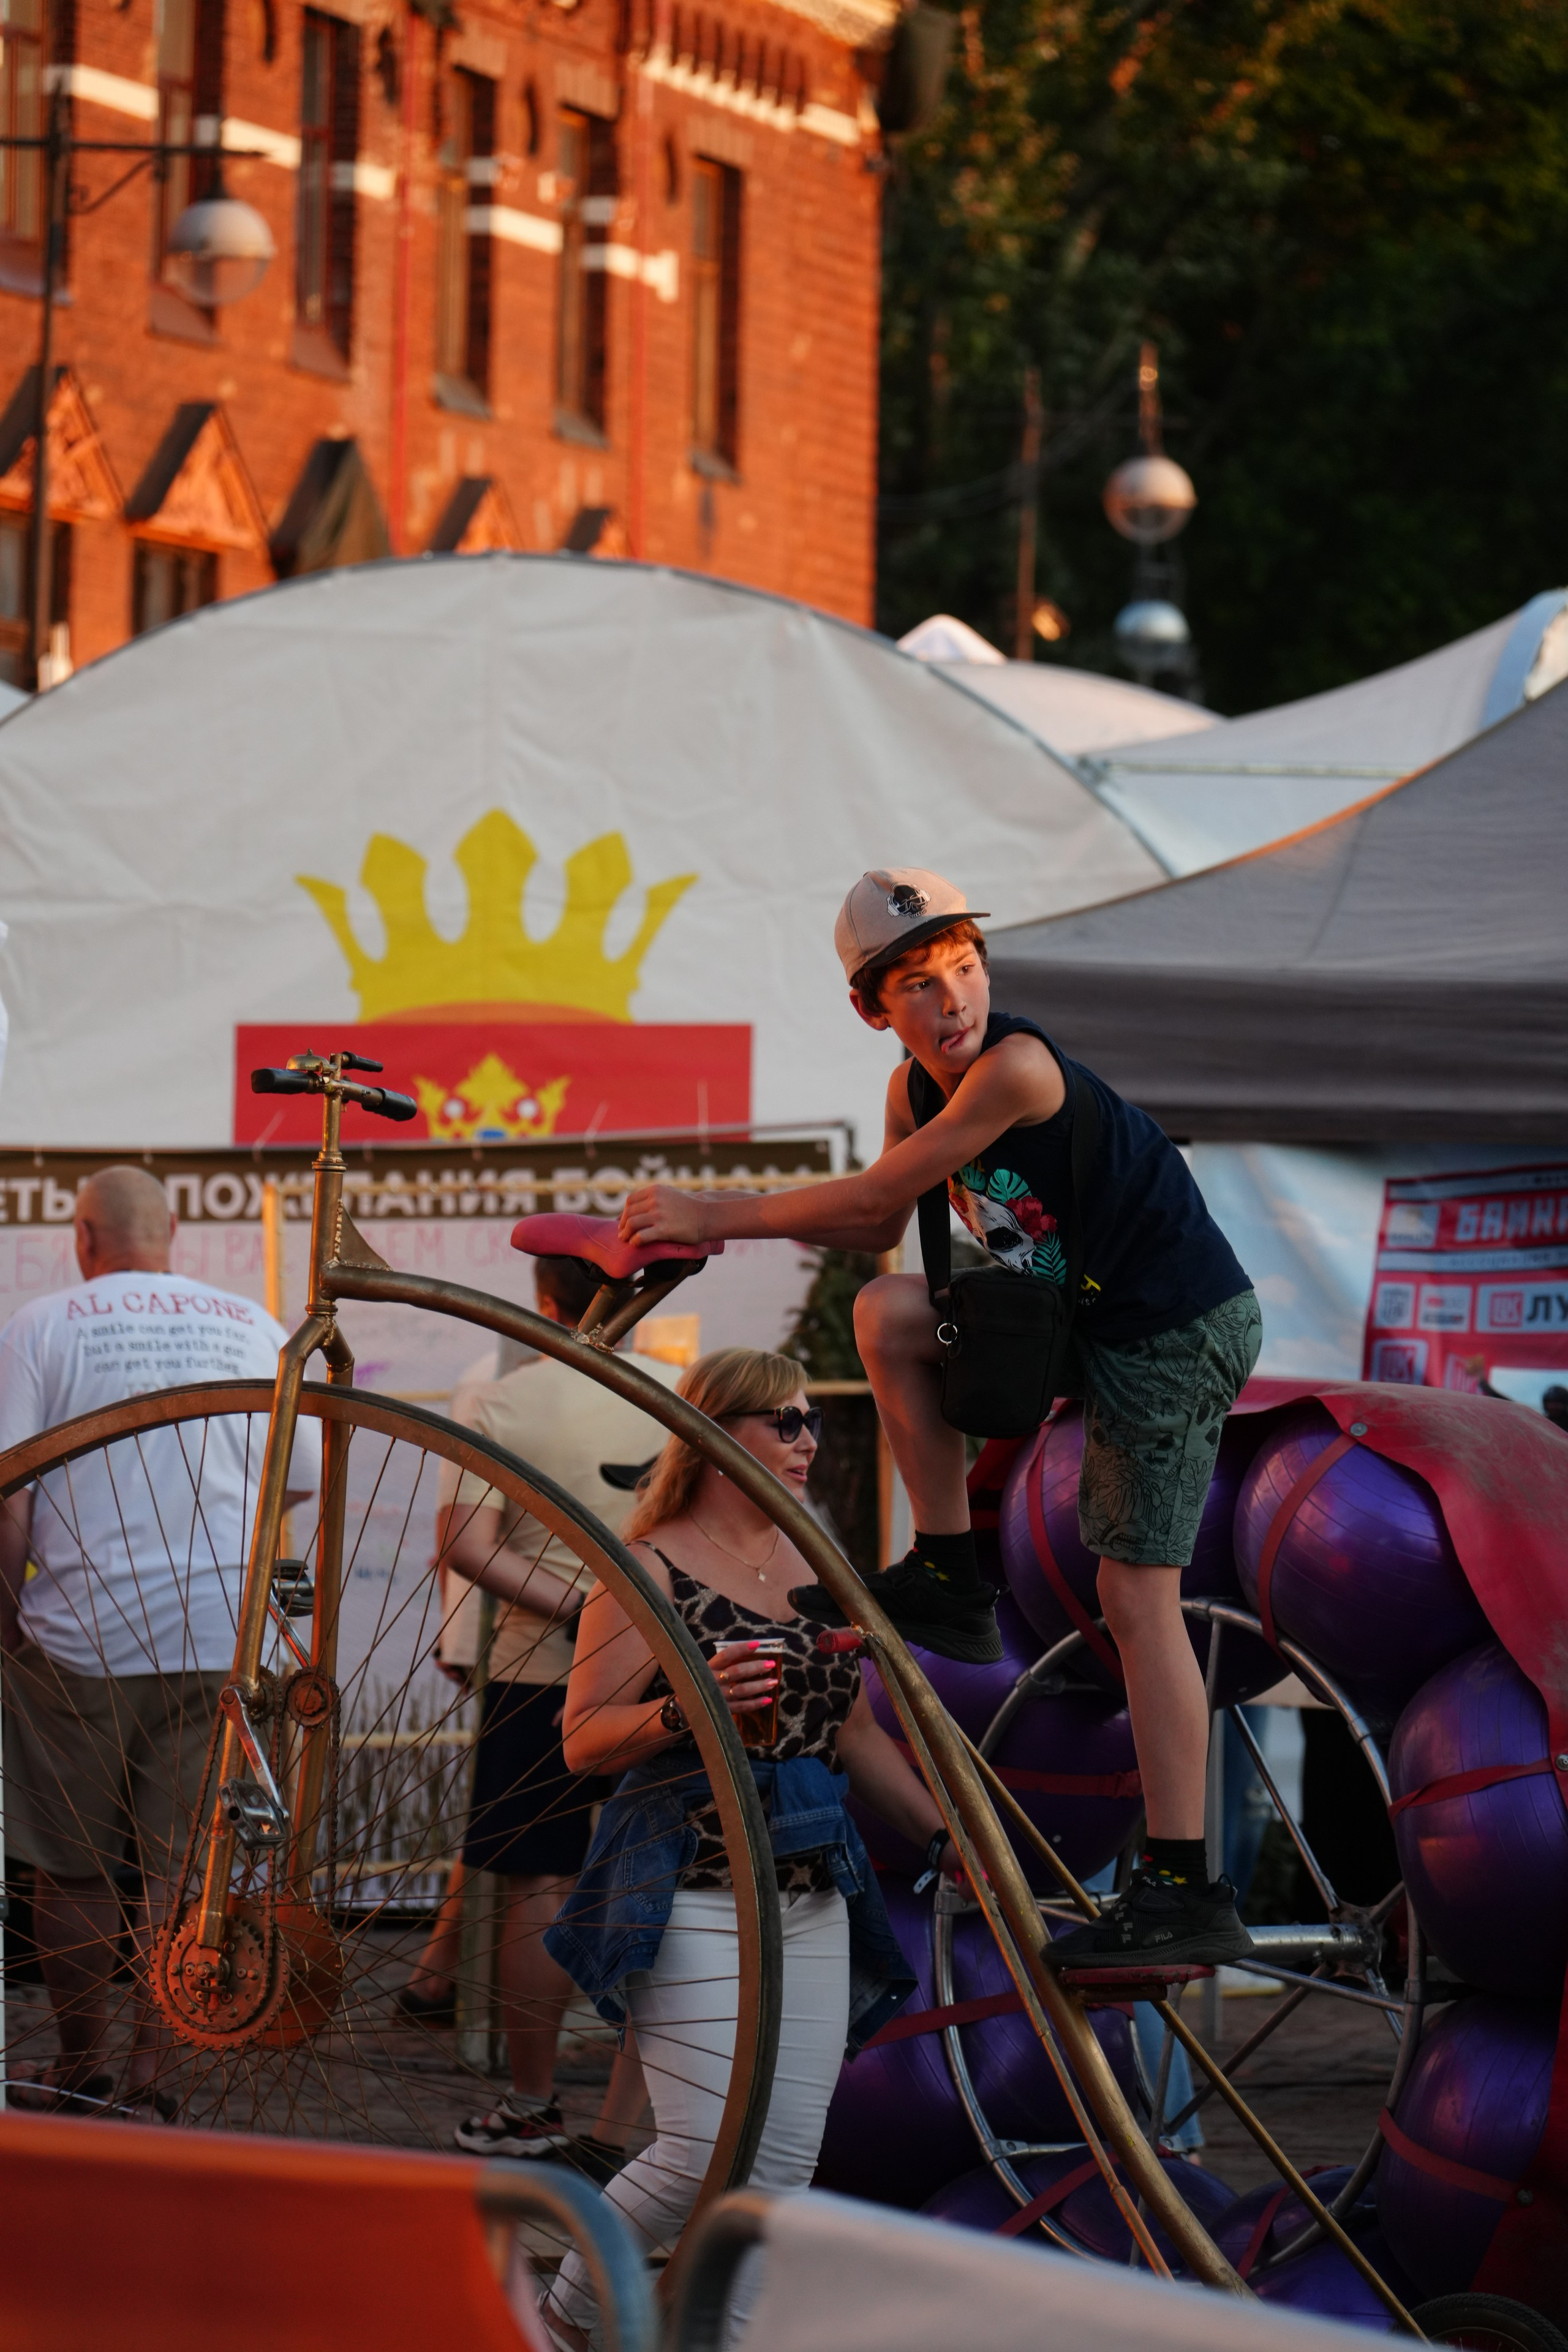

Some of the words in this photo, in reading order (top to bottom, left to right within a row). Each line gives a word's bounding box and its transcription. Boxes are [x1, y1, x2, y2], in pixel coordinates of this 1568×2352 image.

[0, 1177, 91, 1221] ТЫ
[67, 1293, 113, 1320] AL
[123, 1291, 254, 1325] CAPONE
[91, 1322, 134, 1338] smile
[138, 1324, 166, 1335] can
[168, 1322, 194, 1337] get
[198, 1324, 222, 1337] you
[84, 1342, 110, 1357] but
[115, 1342, 124, 1352] a
[127, 1340, 172, 1352] smile
[174, 1340, 210, 1352] with
[223, 1345, 246, 1359] gun
[94, 1360, 120, 1373] can
[124, 1357, 151, 1373] get
[154, 1359, 181, 1371] you
[1142, 1875, 1156, 1887] FILA
[1155, 1931, 1173, 1943] FILA
